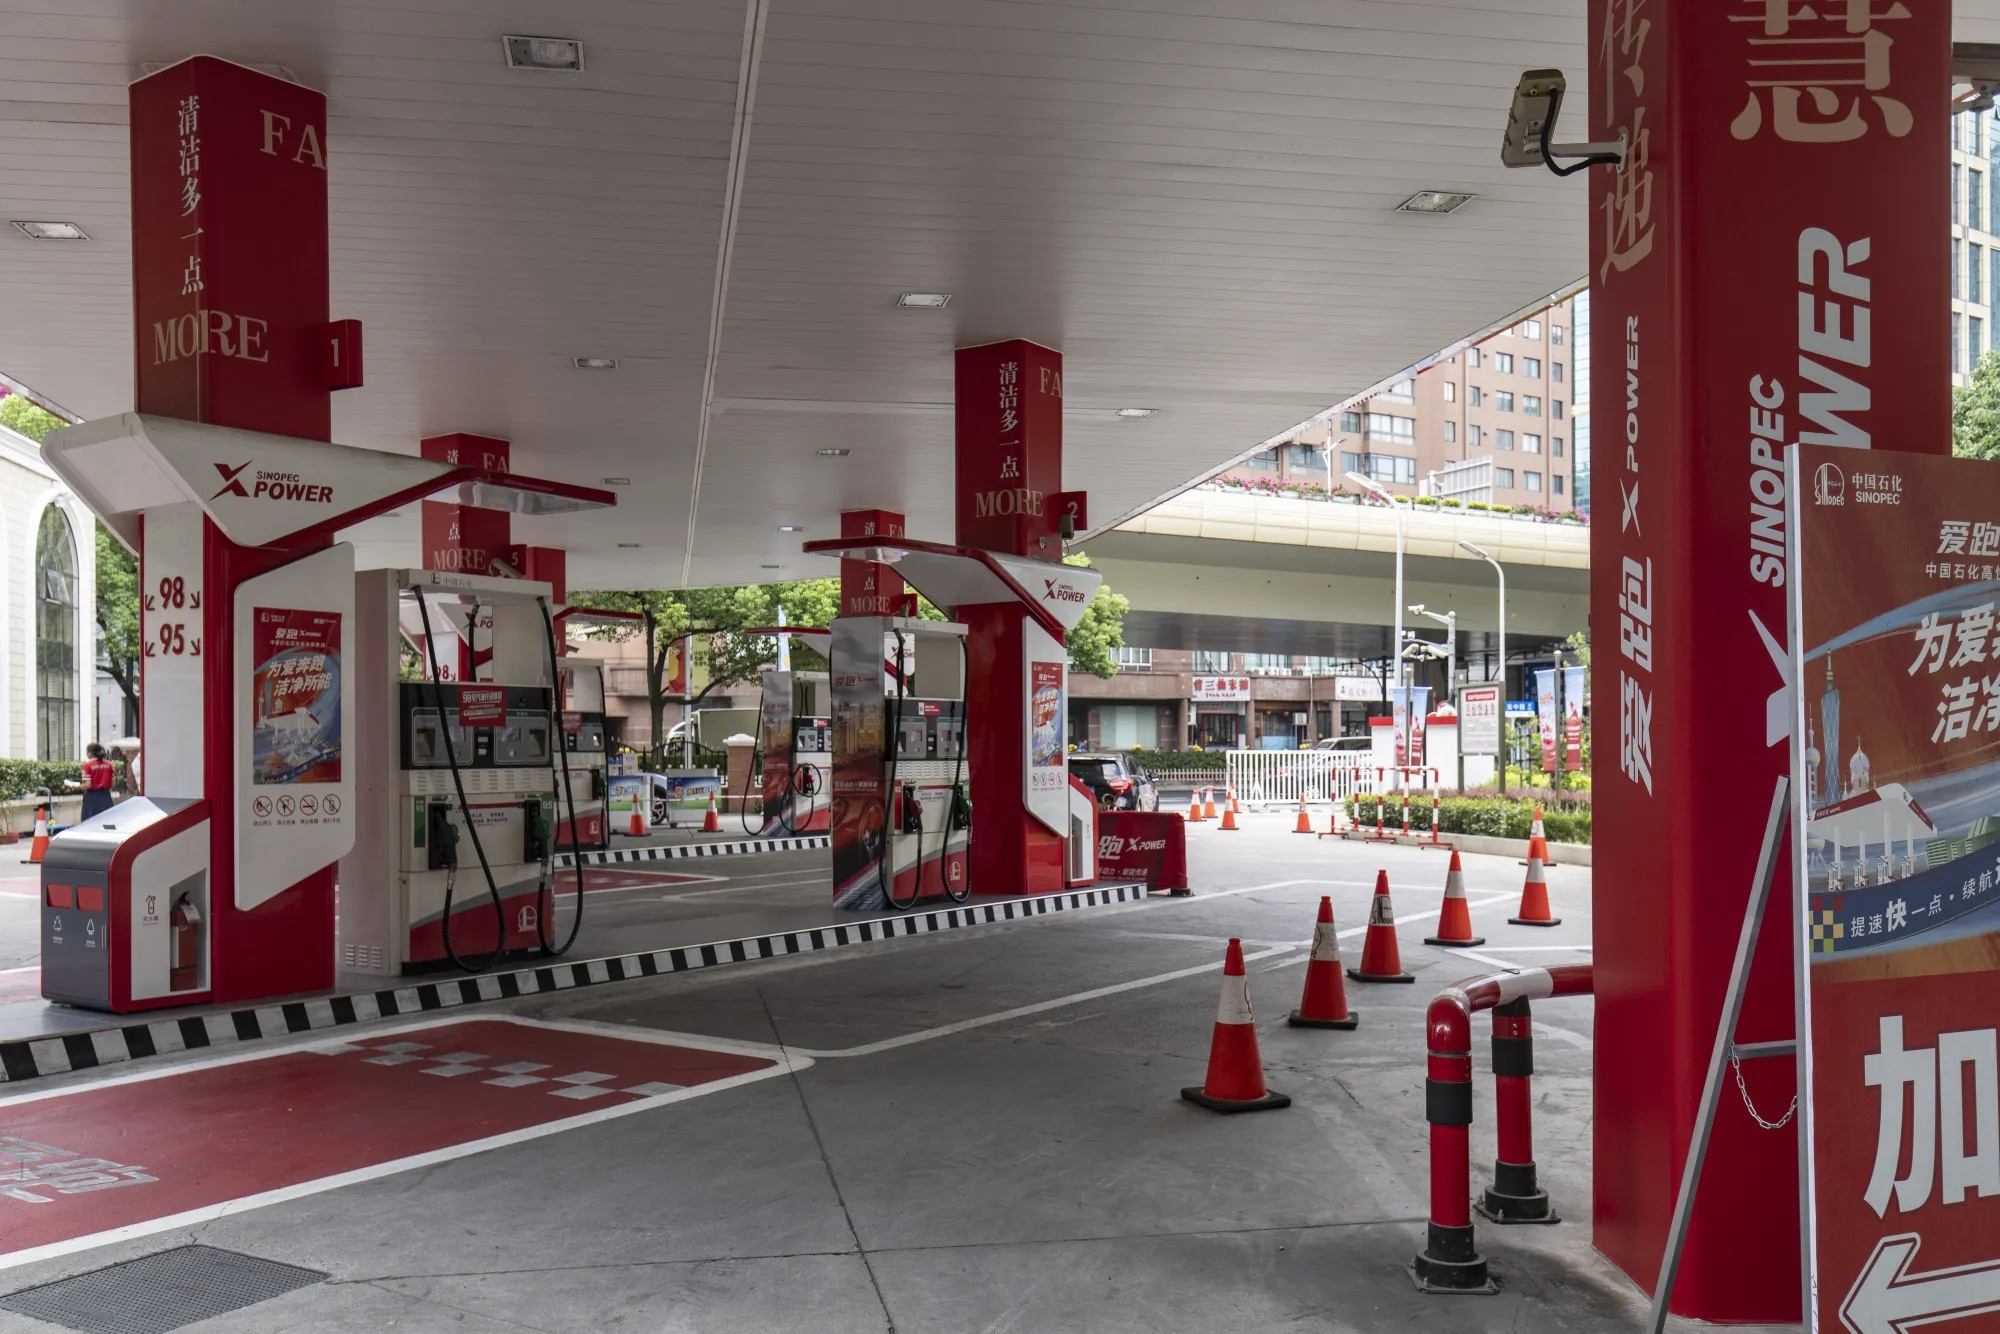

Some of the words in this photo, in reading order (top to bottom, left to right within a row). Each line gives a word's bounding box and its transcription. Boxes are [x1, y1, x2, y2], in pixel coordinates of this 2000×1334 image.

[177, 95, 204, 296] 清洁多一点
[153, 309, 269, 365] MORE
[1798, 227, 1871, 449] WER
[331, 337, 340, 367] 1
[1000, 360, 1020, 479] 清洁多一点
[256, 471, 300, 483] SINOPEC
[1749, 373, 1785, 588] SINOPEC
[1852, 472, 1903, 492] 中国石化
[975, 489, 1043, 518] MORE
[1067, 501, 1078, 518] 2
[1855, 491, 1901, 504] SINOPEC
[1936, 520, 2000, 556] 爱跑
[433, 548, 487, 571] MORE
[511, 552, 519, 566] 5
[159, 576, 185, 610] 98
[850, 596, 891, 613] MORE
[159, 622, 185, 656] 95
[275, 627, 298, 640] 爱跑
[1907, 601, 2000, 677] 为爱
[267, 655, 326, 678] 为爱奔跑
[1618, 556, 1653, 798] 爱跑
[274, 671, 333, 696] 洁净所能
[542, 800, 553, 809] 95
[1863, 1015, 2000, 1220] 加
